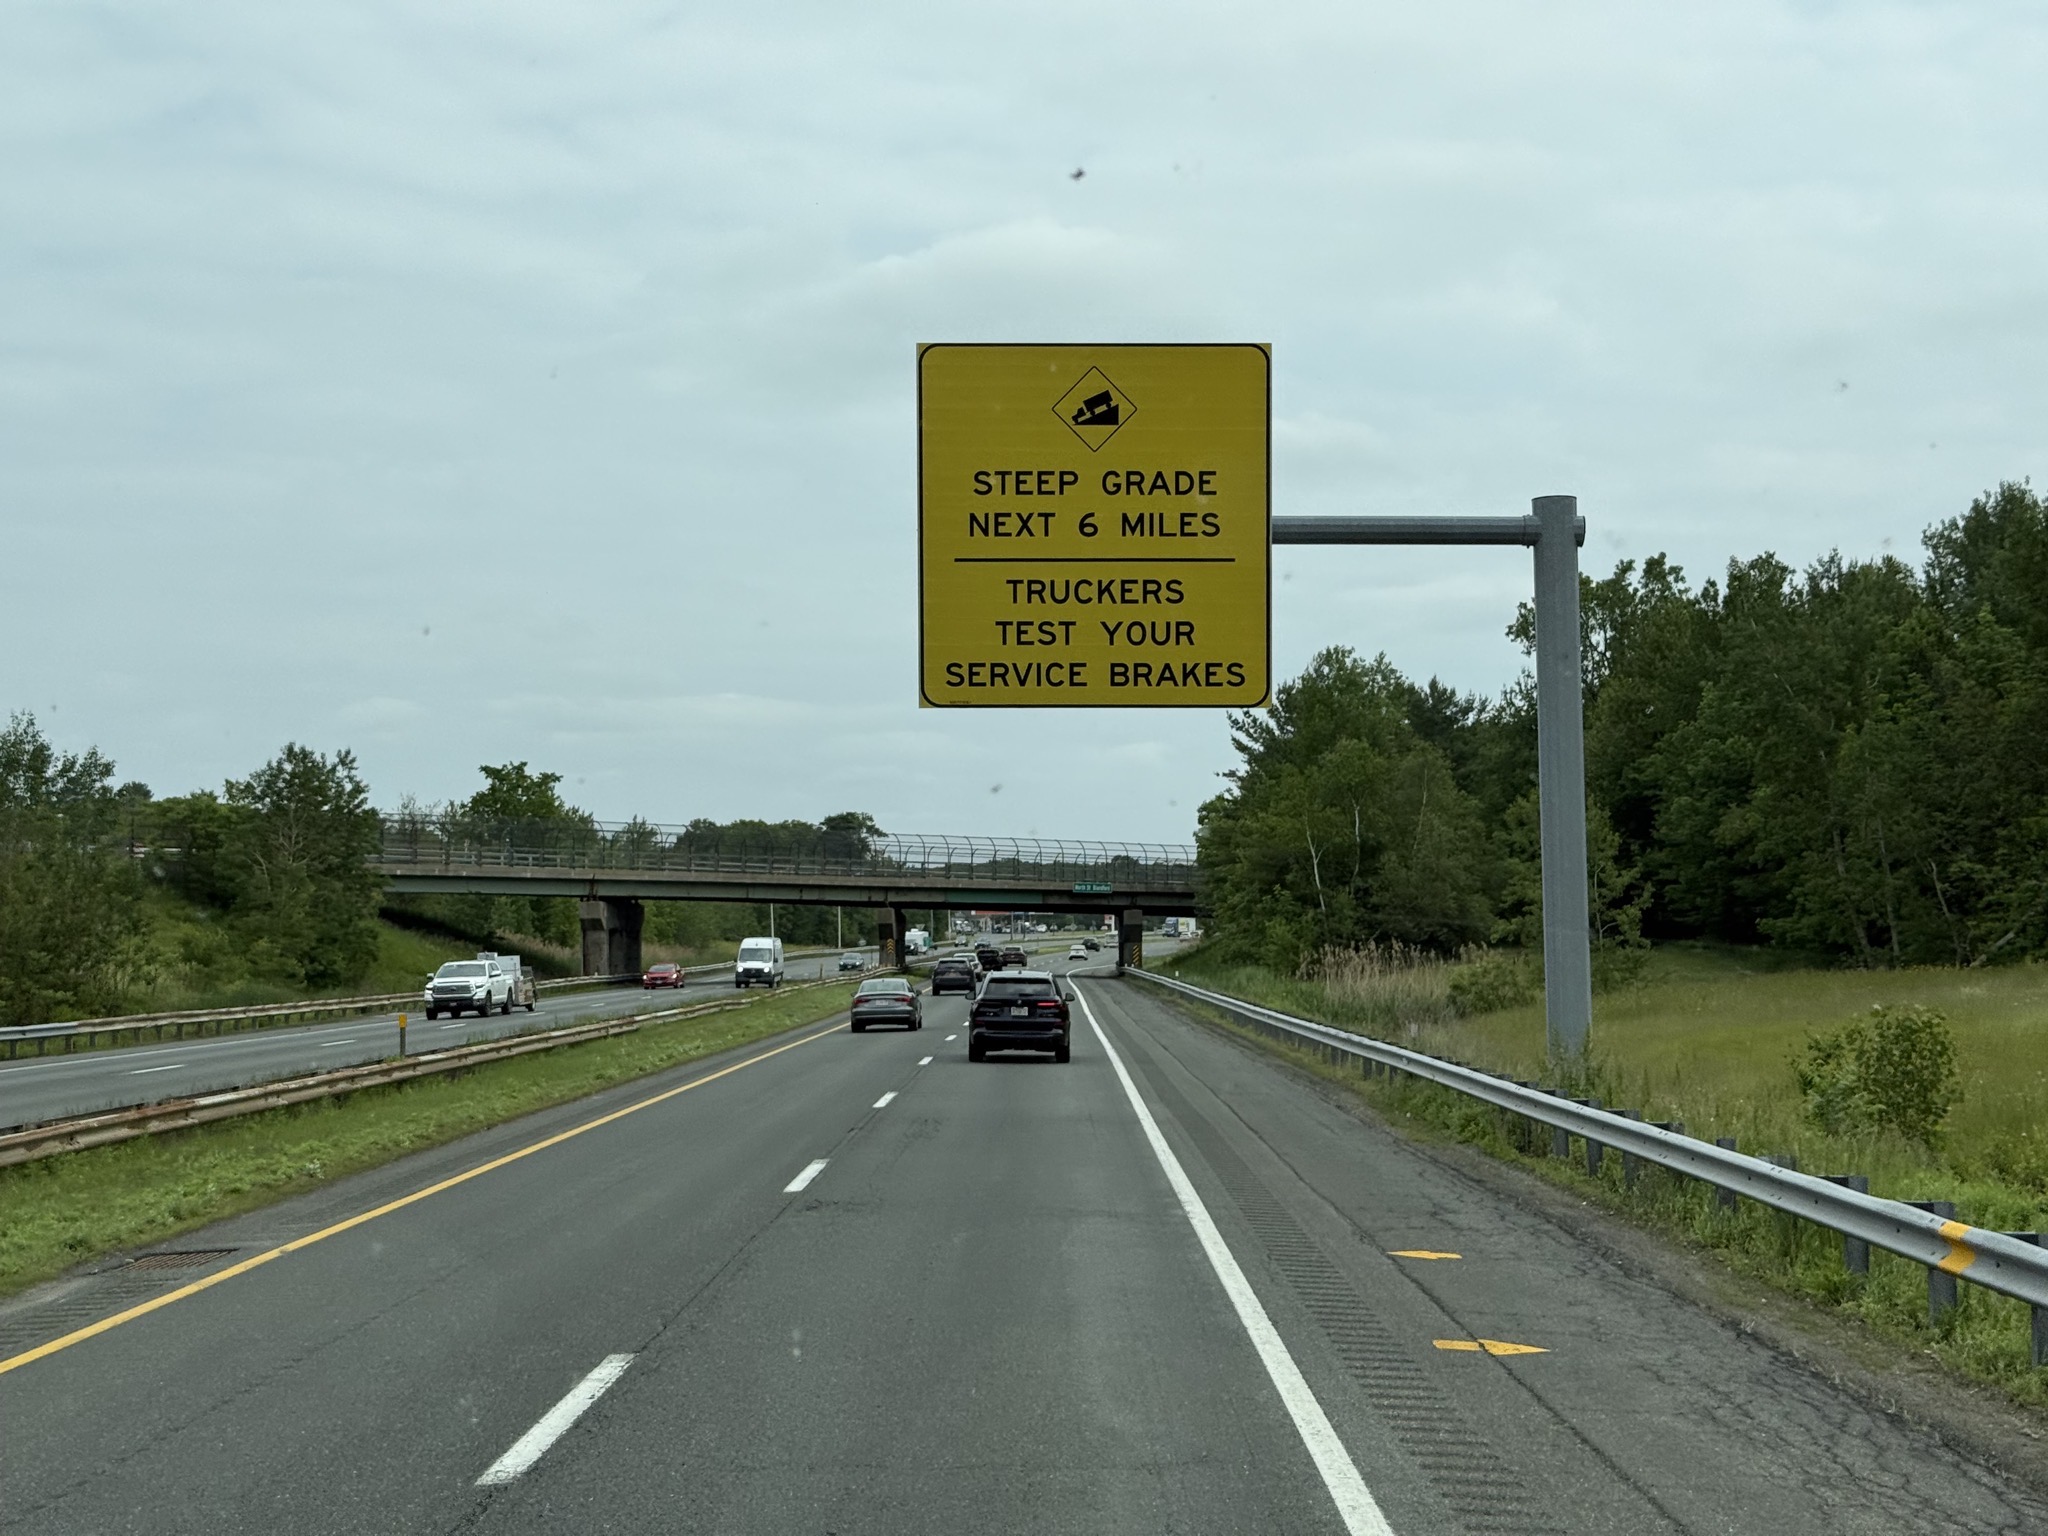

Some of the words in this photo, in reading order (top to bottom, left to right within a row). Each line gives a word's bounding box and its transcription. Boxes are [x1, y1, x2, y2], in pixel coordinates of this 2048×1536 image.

[973, 470, 1079, 496] STEEP
[1101, 470, 1218, 496] GRADE
[969, 512, 1056, 538] NEXT
[1078, 512, 1099, 538] 6
[1121, 512, 1221, 538] MILES
[1005, 578, 1185, 605] TRUCKERS
[994, 620, 1077, 646] TEST
[1099, 620, 1195, 647] YOUR
[945, 662, 1088, 688] SERVICE
[1109, 662, 1246, 688] BRAKES
